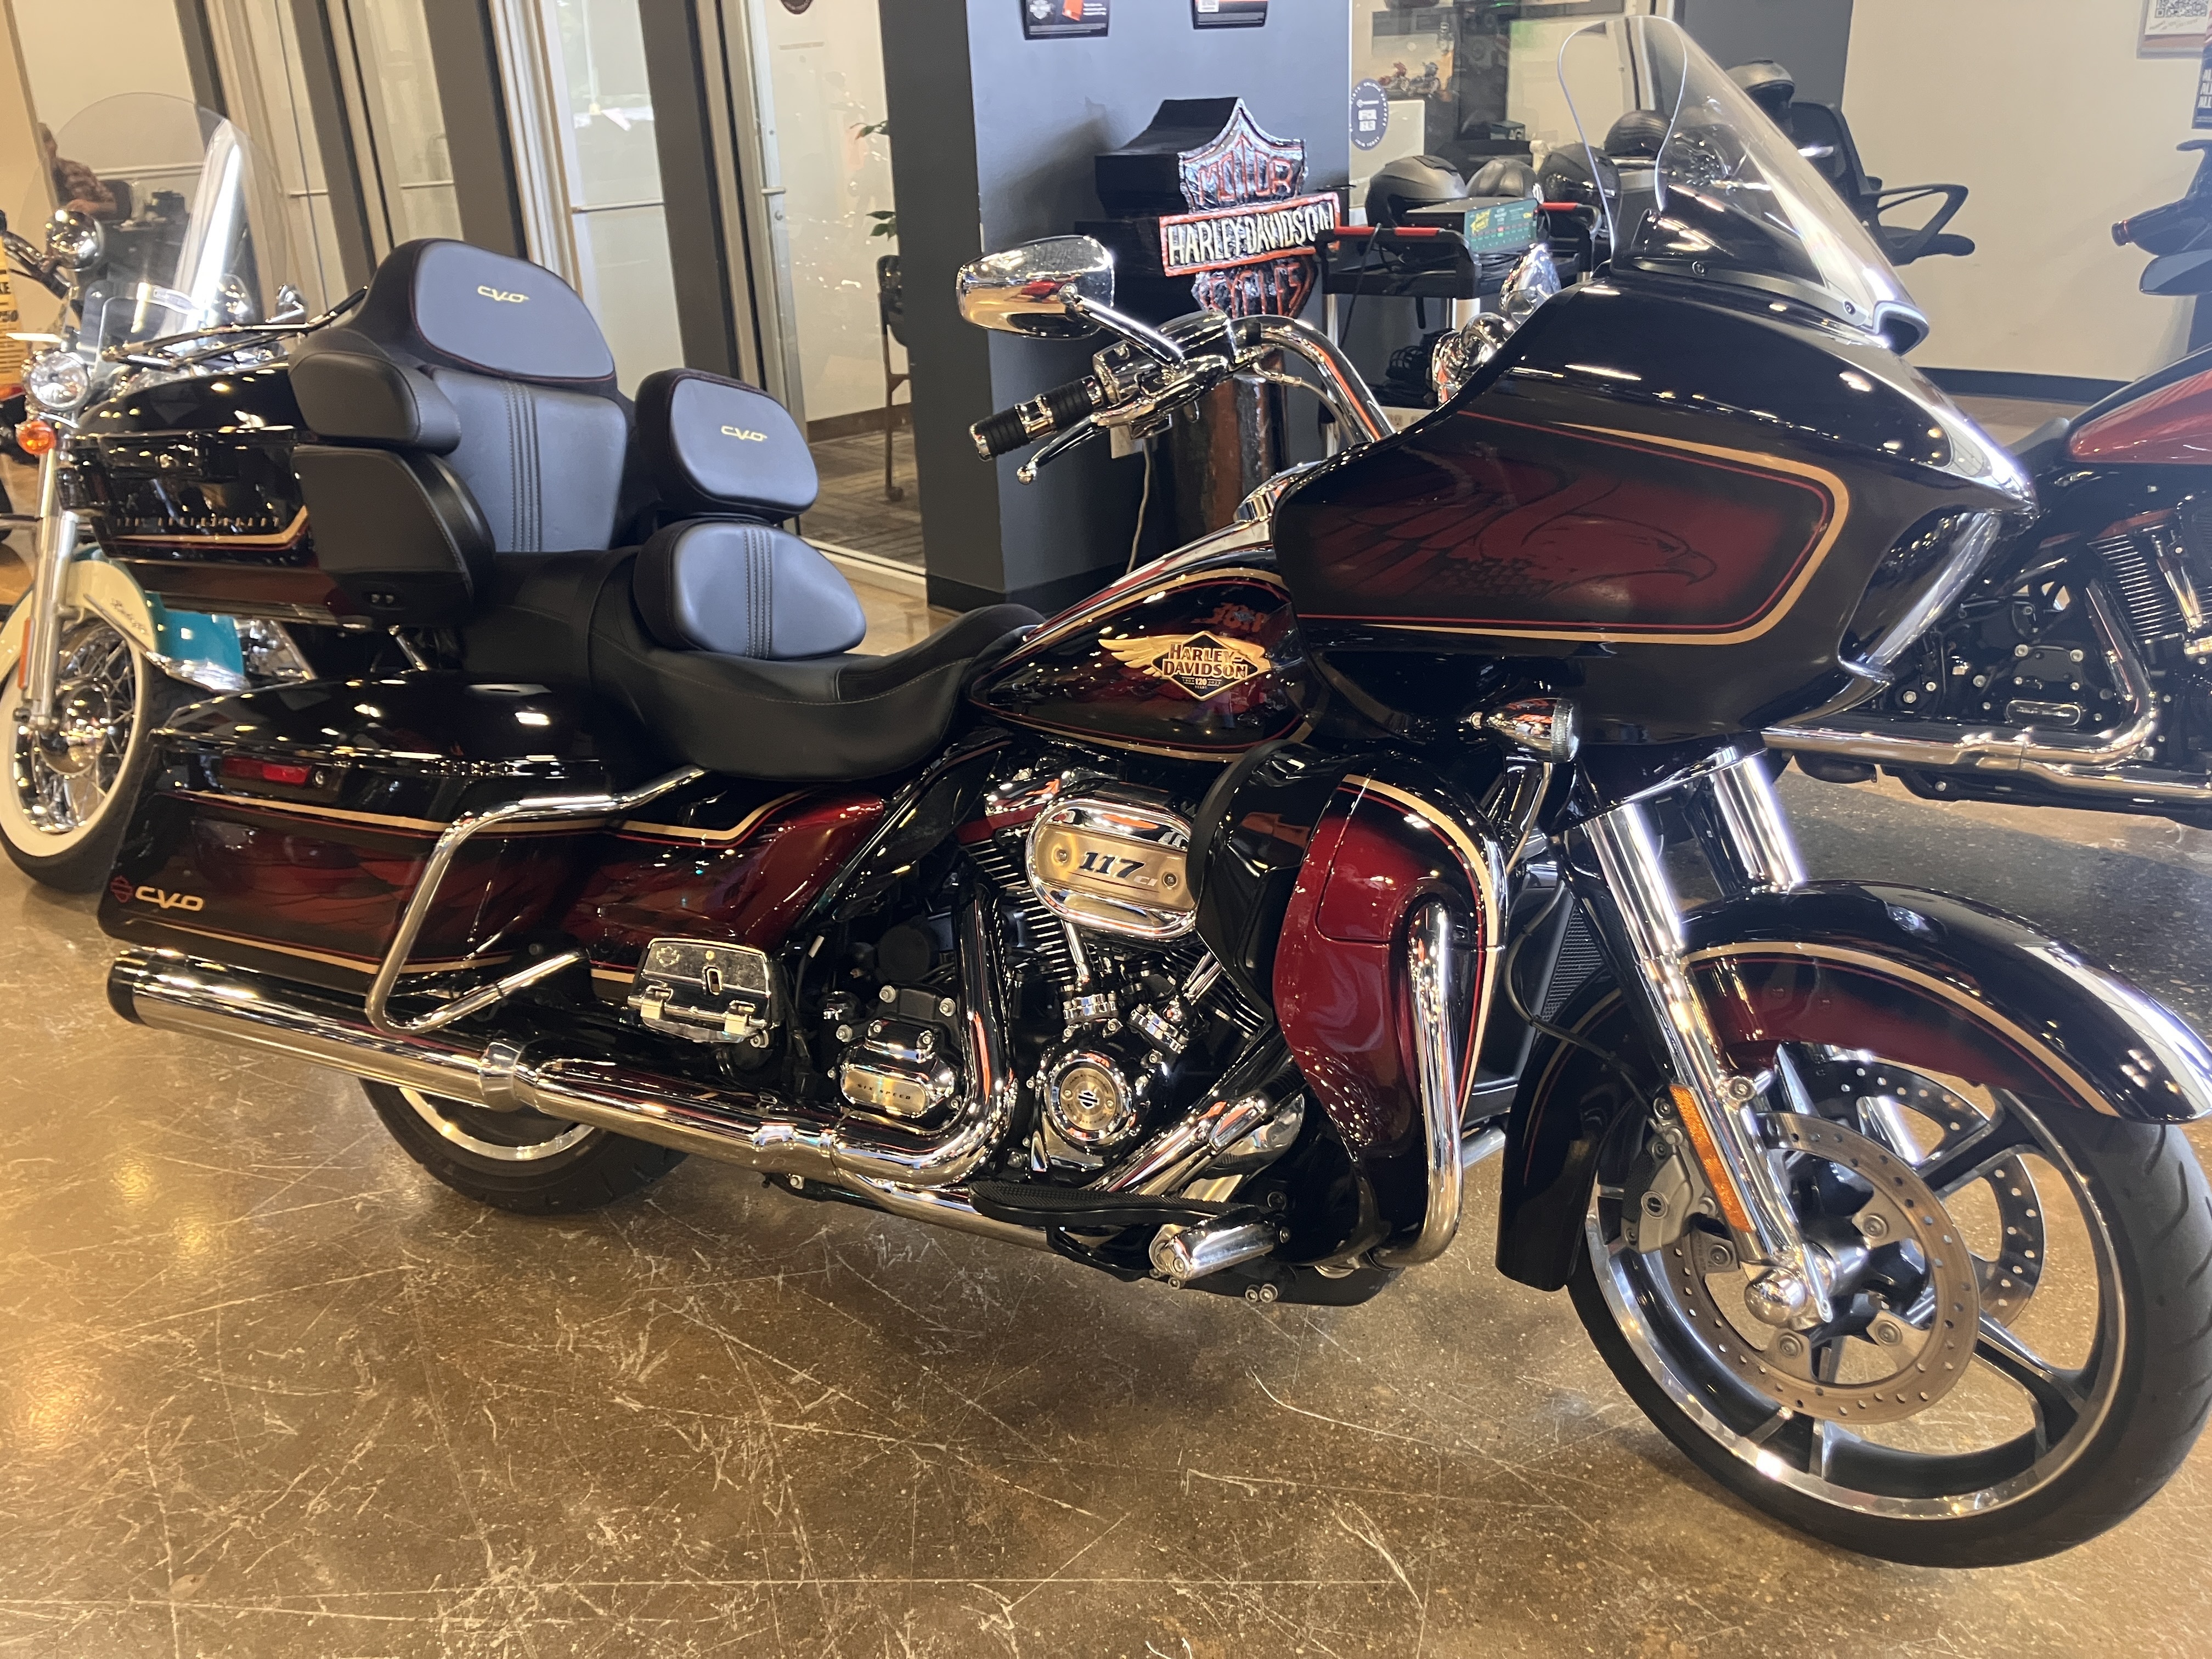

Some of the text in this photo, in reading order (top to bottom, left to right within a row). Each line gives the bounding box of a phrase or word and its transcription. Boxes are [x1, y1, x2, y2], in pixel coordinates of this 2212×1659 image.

[1198, 132, 1293, 205] MOTOR
[477, 285, 530, 303] CVO
[720, 425, 768, 442] CVO
[1163, 660, 1248, 679] DAVIDSON
[1195, 678, 1207, 686] 120
[1079, 851, 1146, 879] 117
[1133, 875, 1159, 887] CI
[135, 885, 204, 912] CVO
[879, 1090, 911, 1099] SPEED
